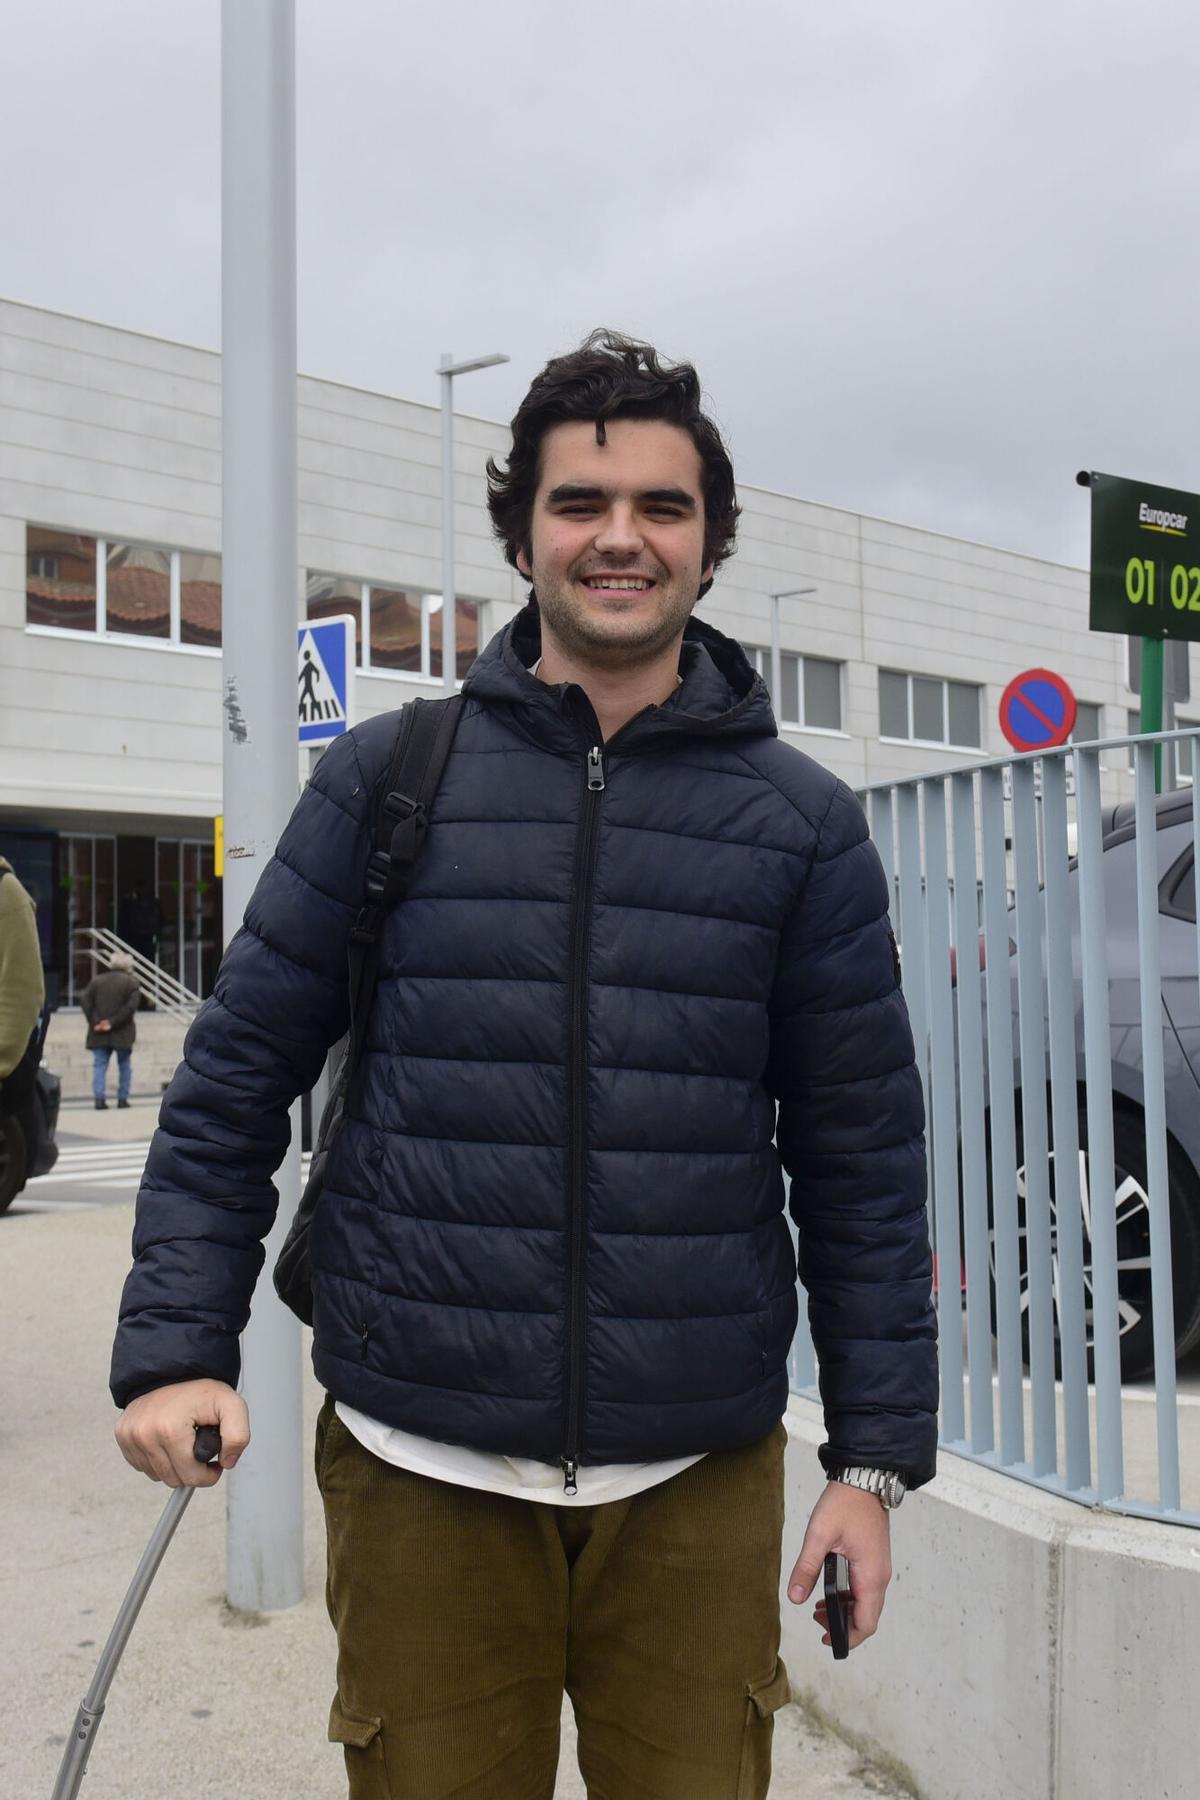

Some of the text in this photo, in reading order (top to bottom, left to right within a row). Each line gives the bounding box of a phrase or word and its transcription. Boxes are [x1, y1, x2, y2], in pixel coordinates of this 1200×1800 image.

[1139, 502, 1188, 532] Europcar
[1125, 557, 1200, 612] 01 02
